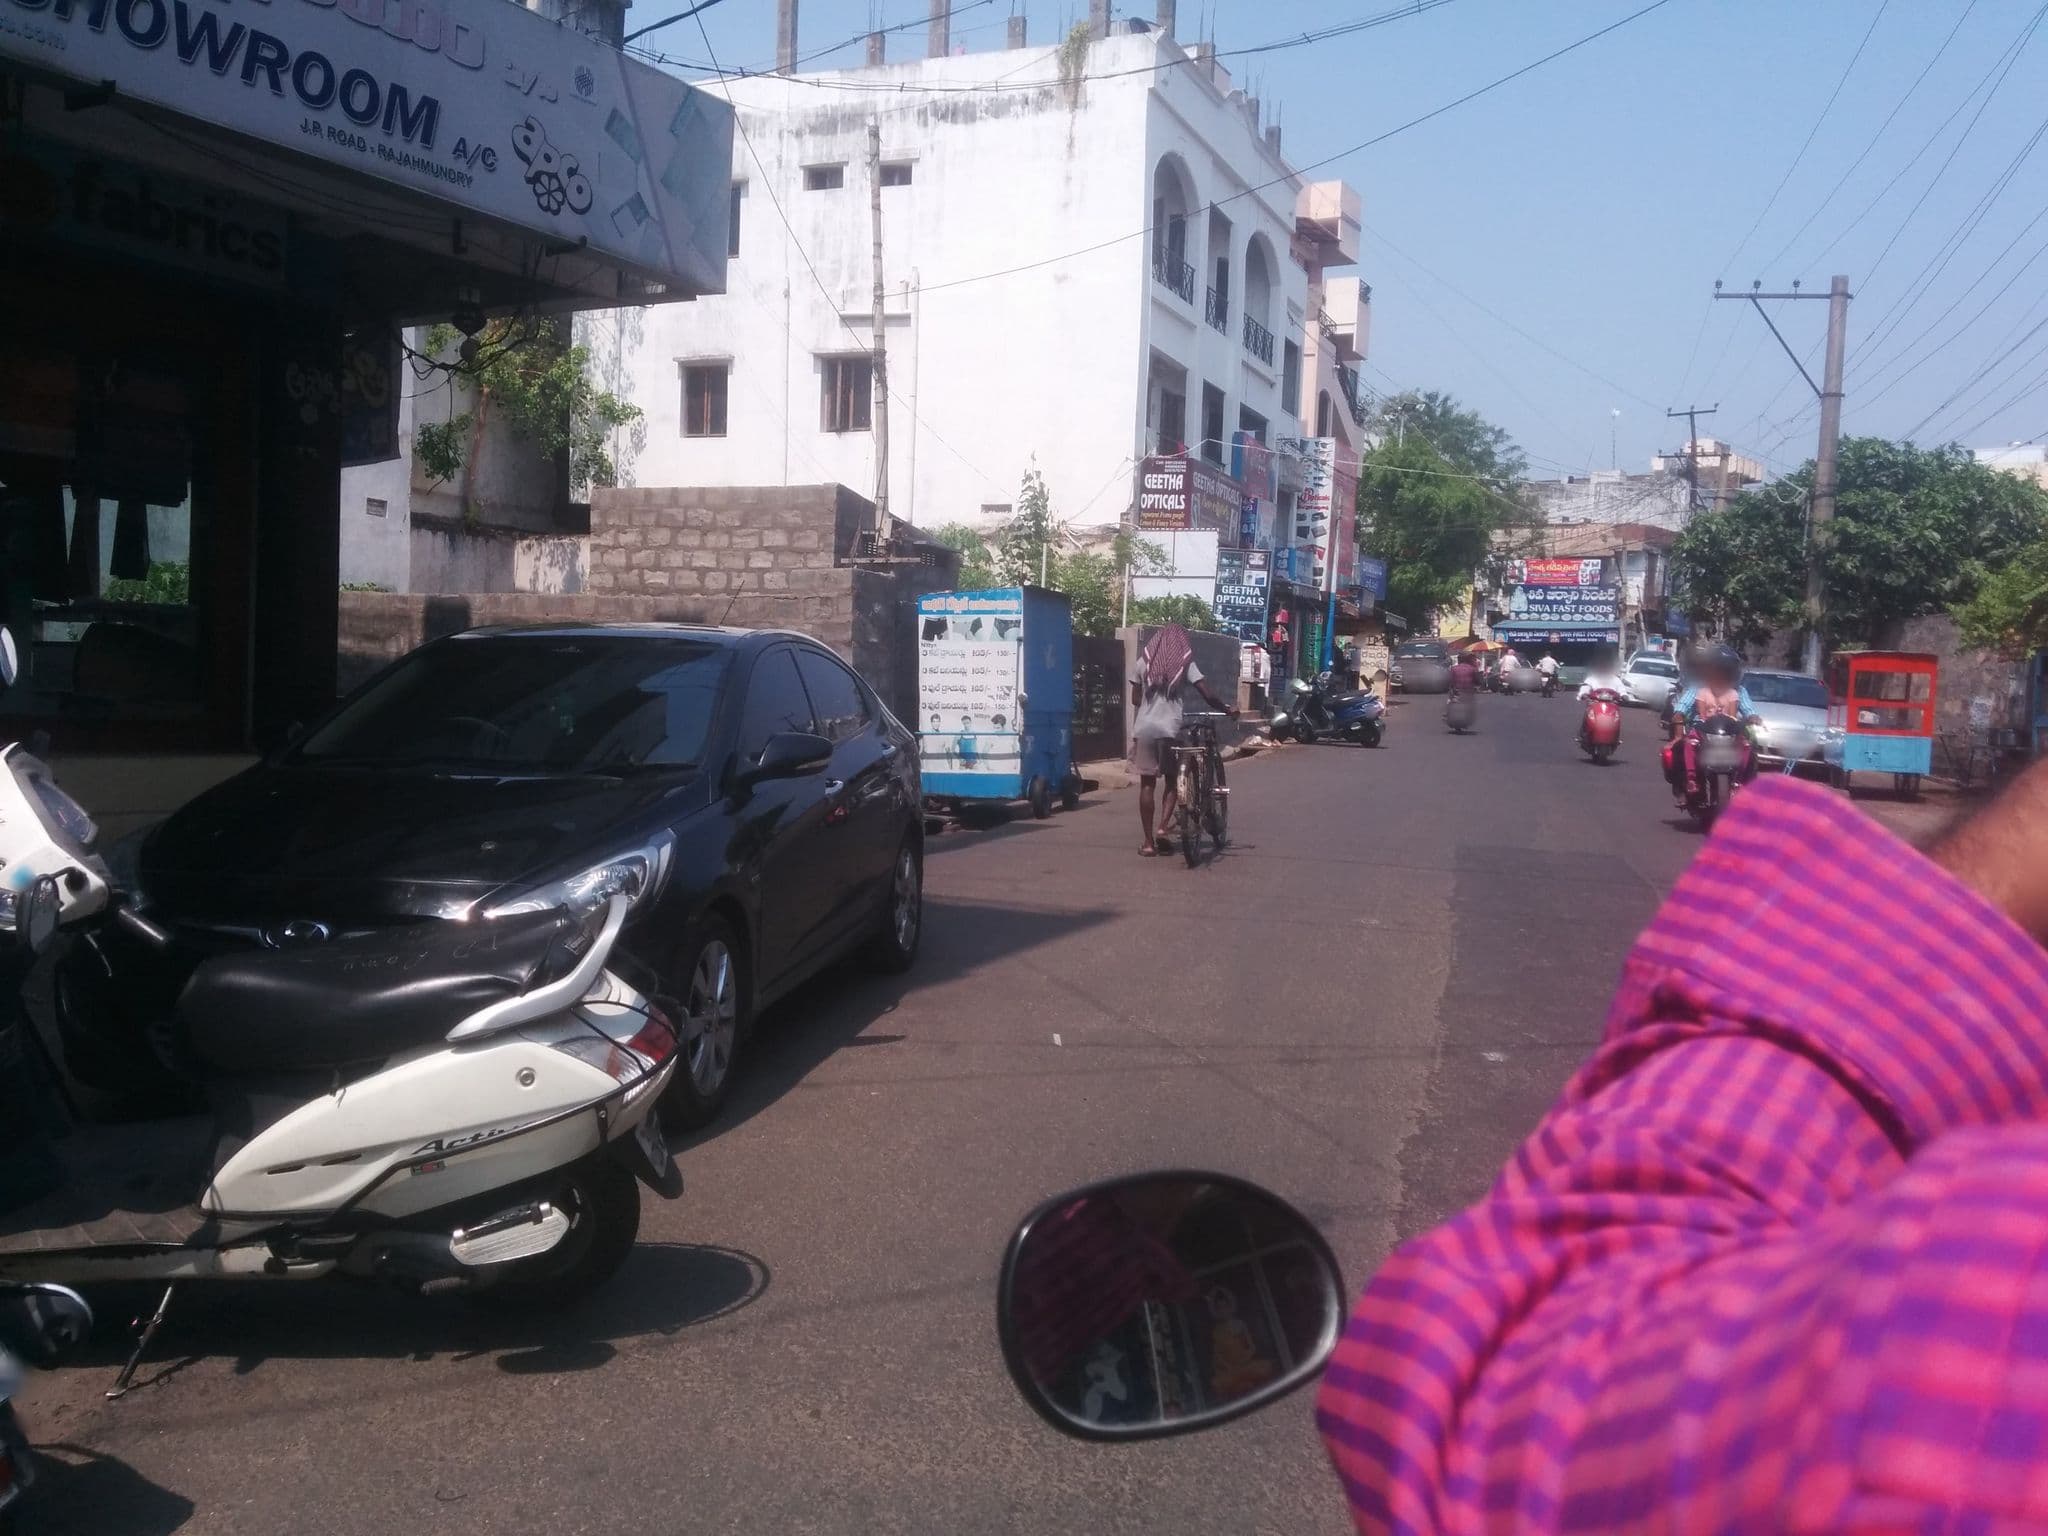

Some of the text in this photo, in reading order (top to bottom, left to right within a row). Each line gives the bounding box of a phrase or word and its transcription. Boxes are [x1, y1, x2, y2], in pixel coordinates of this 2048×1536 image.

[327, 125, 367, 151] ROAD
[377, 143, 473, 188] RAJAHMUNDRY
[452, 136, 498, 172] A/C
[1144, 473, 1184, 490] GEETHA
[1193, 471, 1240, 506] GEETHA OPTICALS
[1140, 493, 1186, 510] OPTICALS
[1221, 585, 1261, 596] GEETHA
[1216, 594, 1265, 606] OPTICALS
[1529, 604, 1613, 613] SIVA FAST FOODS
